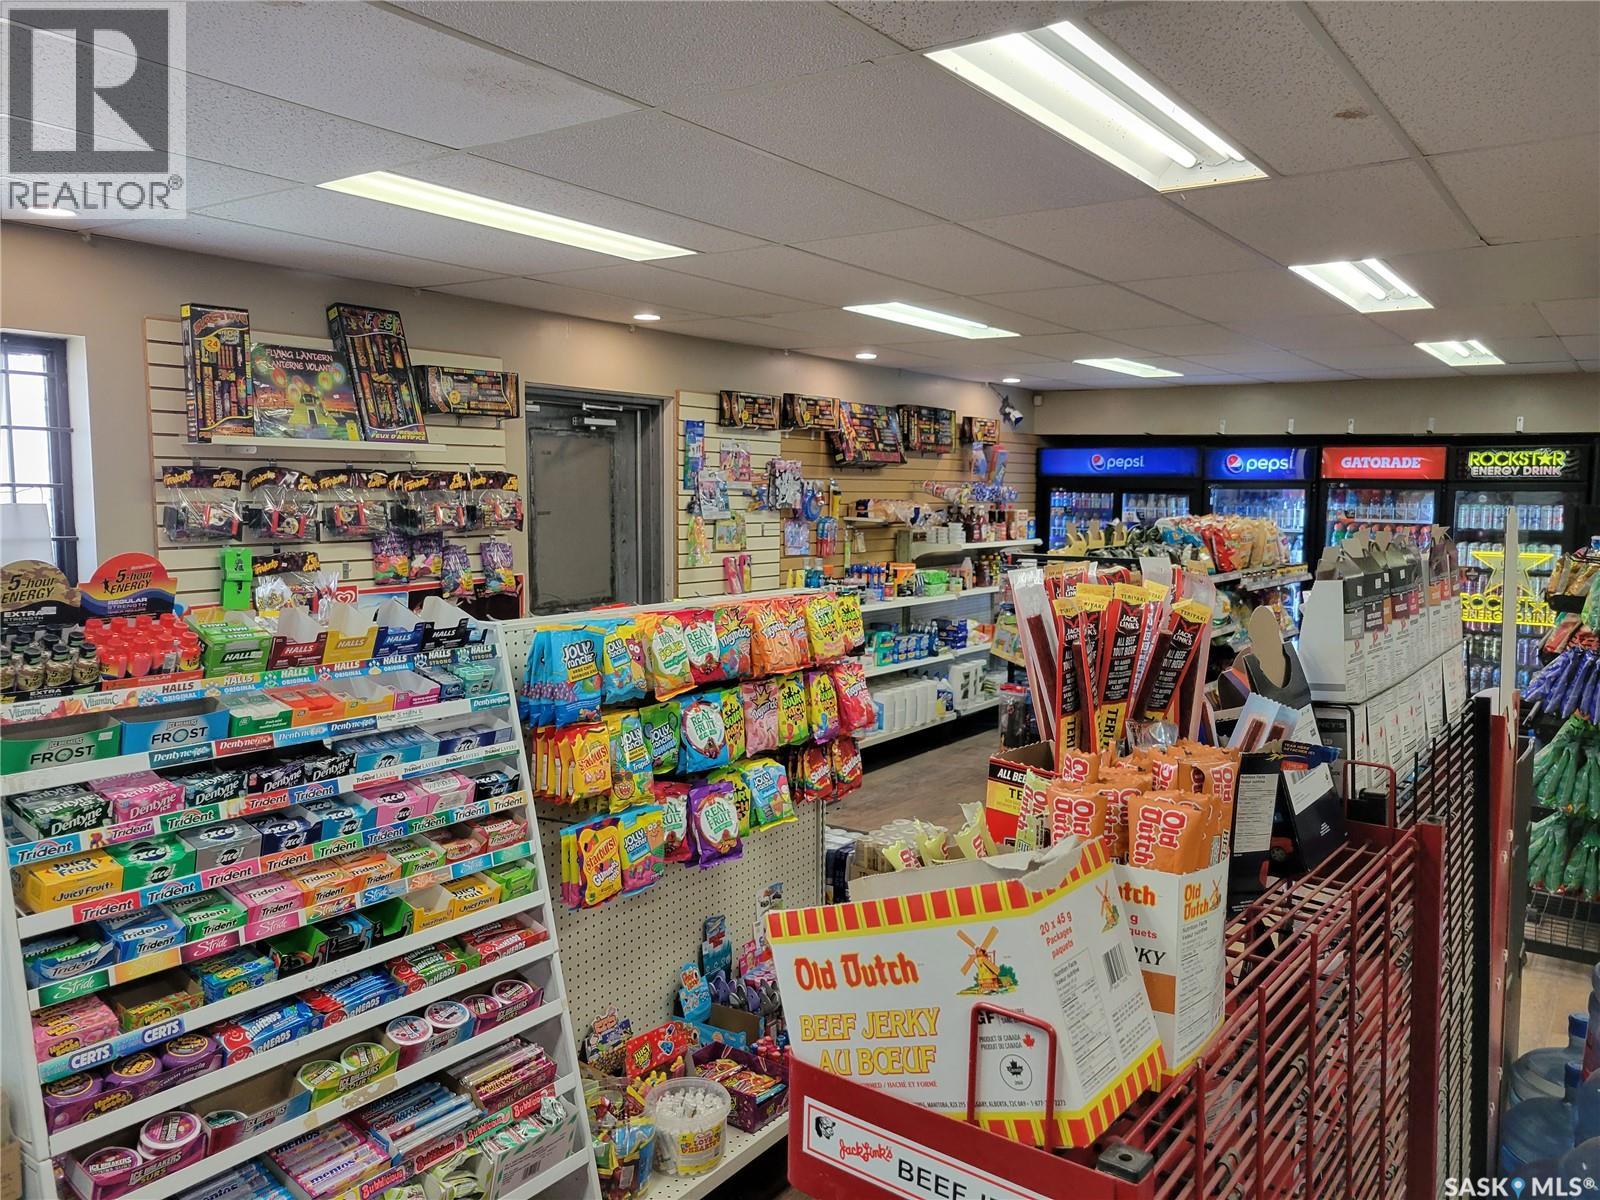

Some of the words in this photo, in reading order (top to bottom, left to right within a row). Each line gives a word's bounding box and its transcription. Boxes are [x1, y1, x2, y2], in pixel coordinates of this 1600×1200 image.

[265, 348, 293, 359] FLYING
[295, 350, 333, 362] LANTERN
[1107, 455, 1144, 471] pepsi
[1246, 455, 1295, 473] pepsi
[1341, 456, 1422, 470] GATORADE
[1471, 466, 1518, 477] ENERGY
[1521, 466, 1562, 477] DRINK
[8, 574, 55, 591] 5-hour
[115, 569, 152, 583] 5-hour
[109, 579, 151, 594] ENERGY
[2, 587, 54, 603] ENERGY
[1122, 615, 1139, 623] JACK
[1181, 609, 1206, 622] TERIYAKI
[386, 633, 412, 644] HALLS
[432, 628, 456, 638] HALLS
[687, 628, 712, 643] REAL
[1177, 629, 1193, 639] JACK
[284, 644, 314, 655] HALLS
[337, 638, 366, 649] HALLS
[470, 644, 492, 655] HALLS
[563, 640, 594, 663] JOLLY
[691, 636, 714, 652] FRUIT
[383, 654, 408, 665] HALLS
[428, 649, 451, 660] HALLS
[429, 657, 452, 666] STRONG
[281, 667, 309, 679] HALLS
[334, 660, 360, 672] HALLS
[334, 669, 363, 678] ORIGINAL
[383, 662, 409, 672] ORIGINAL
[161, 681, 194, 694] HALLS
[223, 674, 254, 686] HALLS
[281, 676, 312, 686] ORIGINAL
[223, 683, 256, 694] ORIGINAL
[162, 691, 198, 703] ORIGINAL
[782, 694, 802, 708] SOUR
[691, 712, 712, 724] REAL
[151, 726, 208, 745] FROST
[695, 721, 716, 734] FRUIT
[29, 744, 96, 766] FROST
[312, 758, 351, 781] Dentyne
[376, 770, 400, 780] LAYERS
[997, 768, 1011, 780] ALL
[1011, 771, 1027, 784] BEE
[264, 769, 302, 793] Dentyne
[1222, 767, 1235, 803] Old
[195, 781, 239, 806] Dentyne
[250, 793, 288, 810] Trident
[294, 786, 334, 802] Trident
[129, 793, 177, 820] Dentyne
[494, 796, 523, 811] Trident
[704, 804, 729, 818] REAL
[51, 806, 103, 836] Dentyne
[167, 810, 214, 830] Trident
[454, 806, 485, 822] Trident
[708, 811, 732, 829] FRUIT
[1073, 799, 1096, 837] Old
[112, 823, 152, 839] Trident
[413, 816, 446, 832] Trident
[1158, 809, 1188, 850] Old
[367, 828, 403, 844] Trident
[490, 832, 518, 845] Trident
[623, 830, 645, 847] JOLLY
[1133, 805, 1163, 865] Dutch
[18, 841, 73, 864] Trident
[320, 840, 357, 857] Trident
[399, 849, 430, 863] Trident
[267, 853, 308, 872] Trident
[350, 863, 385, 878] Trident
[413, 858, 439, 872] Trident
[209, 867, 252, 887] Trident
[300, 871, 337, 886] Trident
[366, 871, 394, 885] Trident
[148, 884, 195, 903] Trident
[249, 883, 286, 899] Trident
[315, 886, 345, 901] Trident
[1183, 883, 1202, 901] Old
[82, 900, 134, 921] Trident
[188, 908, 230, 924] Trident
[262, 901, 293, 916] Trident
[1183, 901, 1210, 921] Dutch
[203, 920, 237, 935] Trident
[256, 918, 288, 936] Stride
[1039, 923, 1050, 936] 20
[1051, 920, 1056, 930] x
[1056, 912, 1066, 925] 45
[1067, 911, 1073, 922] g
[121, 924, 167, 941] Trident
[1046, 926, 1073, 947] Packages
[138, 936, 175, 953] Trident
[194, 938, 229, 958] Stride
[1052, 940, 1074, 960] paquets
[52, 957, 98, 978] Trident
[793, 956, 838, 992] Old
[840, 951, 920, 988] Dutch
[53, 976, 95, 1000] Stride
[144, 1020, 180, 1044] CERTS
[800, 1012, 857, 1042] BEEF
[861, 1007, 941, 1040] JERKY
[1003, 1034, 1021, 1042] CANADA
[1005, 1042, 1023, 1050] CANADA
[71, 1045, 111, 1069] CERTS
[820, 1048, 853, 1077] AU
[467, 1114, 504, 1140] Bubblicious
[275, 1130, 321, 1154] mentos
[838, 1139, 865, 1161] Jack
[143, 1151, 182, 1176] BREAKERS
[416, 1140, 456, 1171] Bubblicious
[310, 1158, 356, 1184] mentos
[897, 1158, 968, 1200] BEEF
[361, 1168, 405, 1198] Bubblicious
